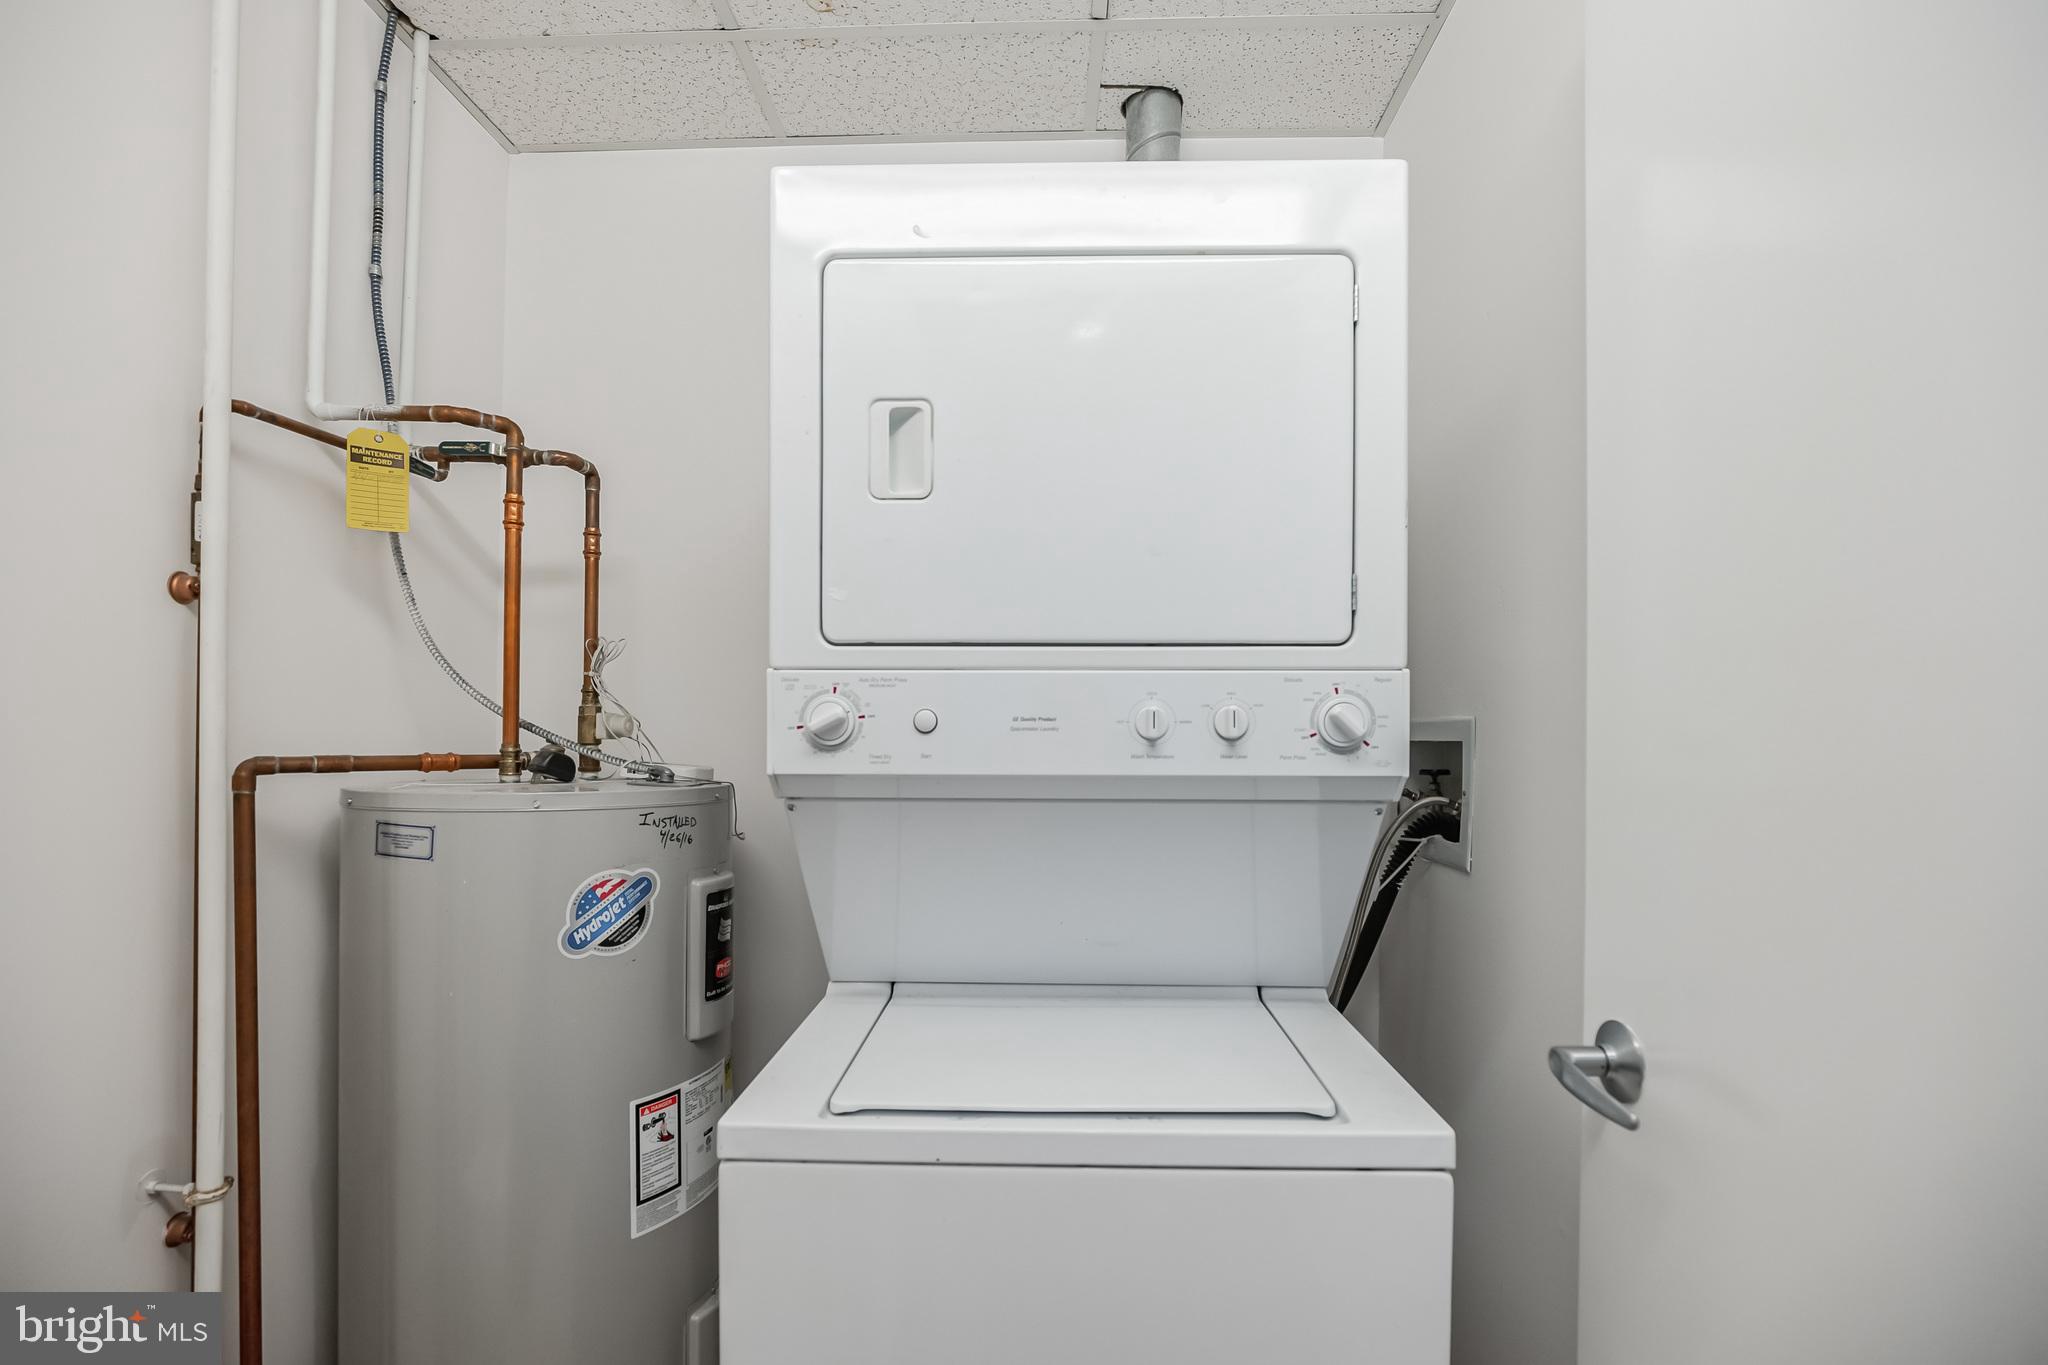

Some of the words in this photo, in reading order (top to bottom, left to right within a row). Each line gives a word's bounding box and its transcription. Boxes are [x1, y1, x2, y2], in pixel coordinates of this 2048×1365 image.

[351, 447, 403, 461] MAINTENANCE
[362, 456, 393, 466] RECORD
[639, 811, 697, 829] INSTALLED
[660, 829, 693, 848] 4/26/16
[573, 896, 627, 945] Hydrojet
